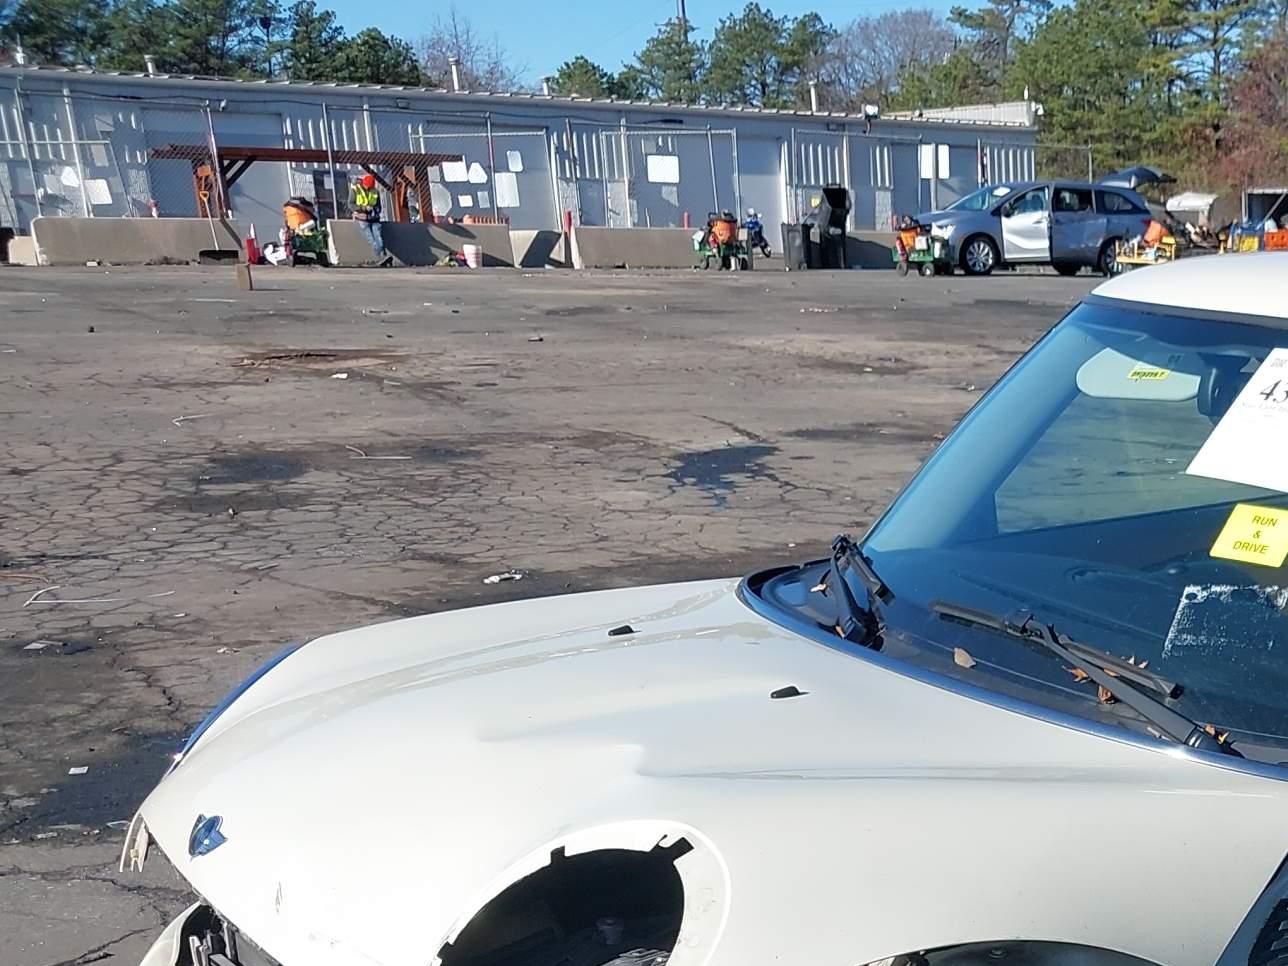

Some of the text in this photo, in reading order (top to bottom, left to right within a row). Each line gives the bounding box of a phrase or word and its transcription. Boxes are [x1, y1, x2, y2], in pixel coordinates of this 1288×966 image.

[1251, 515, 1279, 528] RUN
[1252, 529, 1261, 540] &
[1232, 540, 1270, 555] DRIVE
